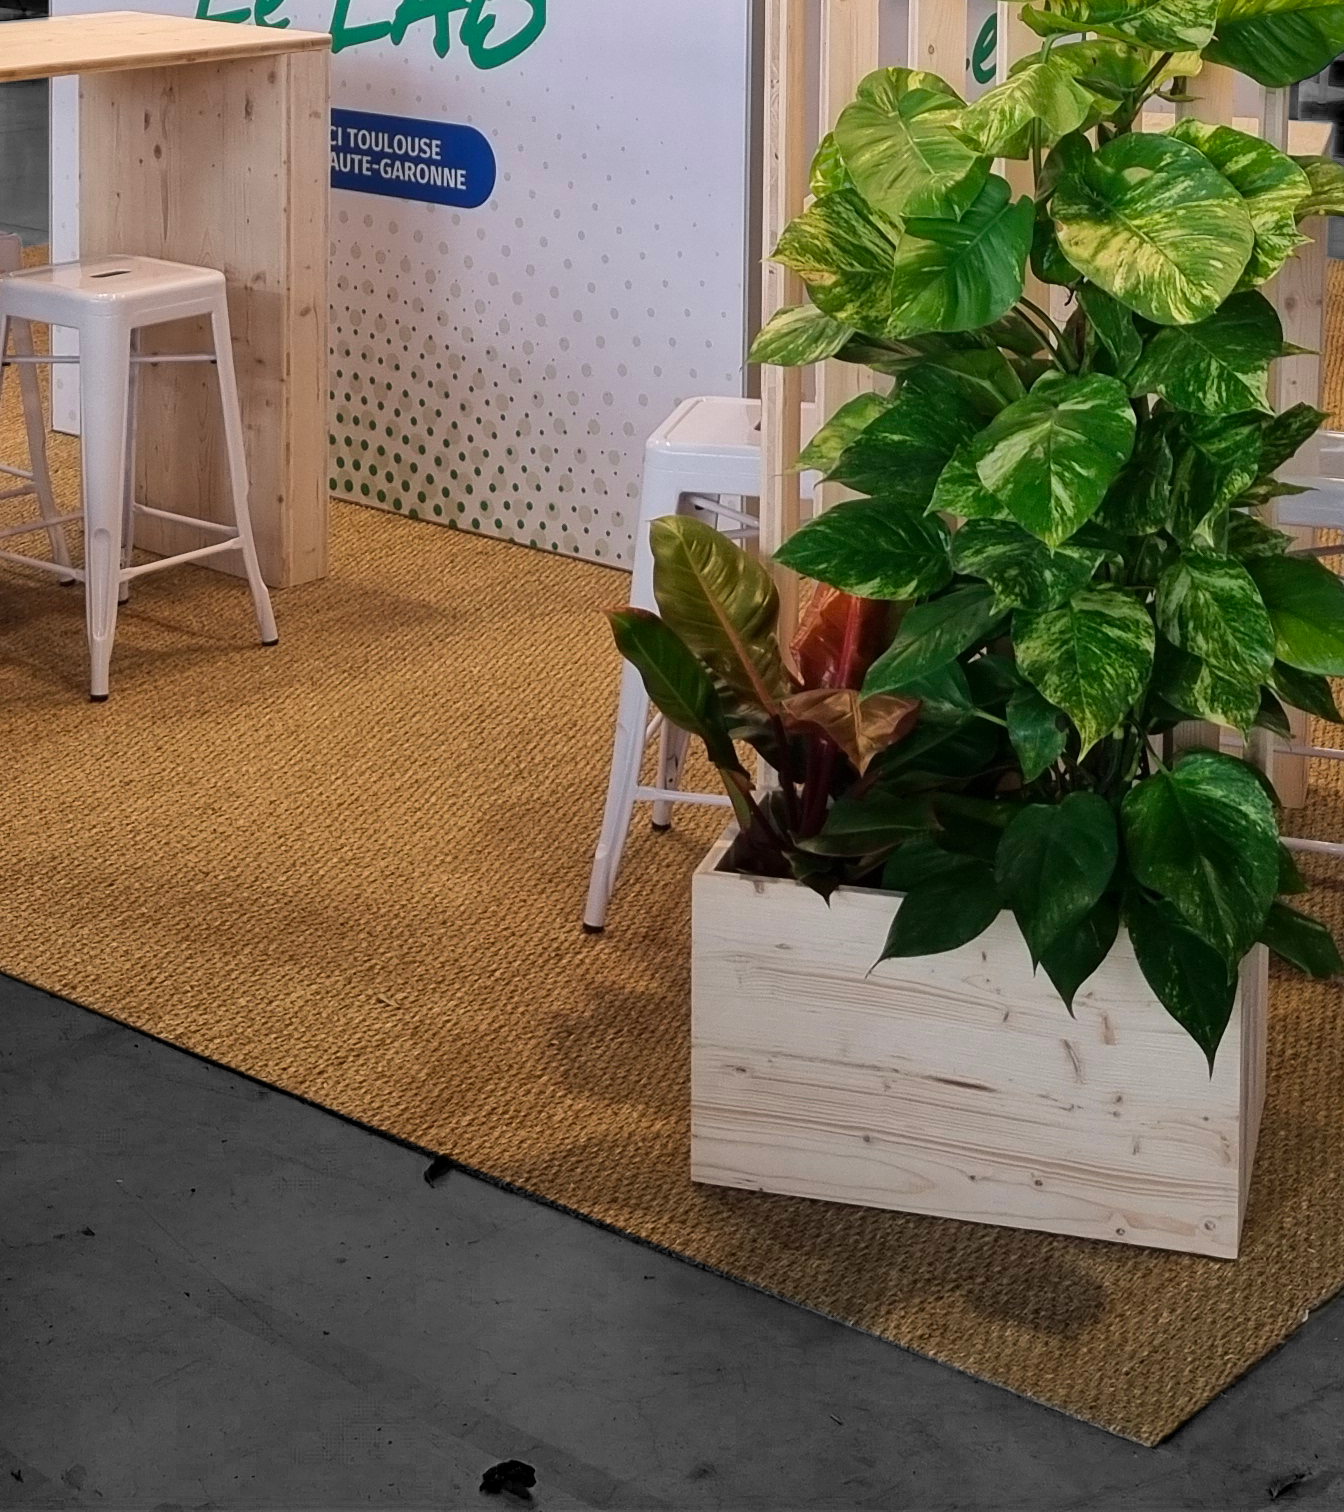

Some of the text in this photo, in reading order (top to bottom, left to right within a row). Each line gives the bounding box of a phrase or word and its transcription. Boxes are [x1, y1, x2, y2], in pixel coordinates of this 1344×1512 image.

[330, 125, 442, 160] CI TOULOUSE
[330, 151, 467, 190] AUTE-GARONNE
